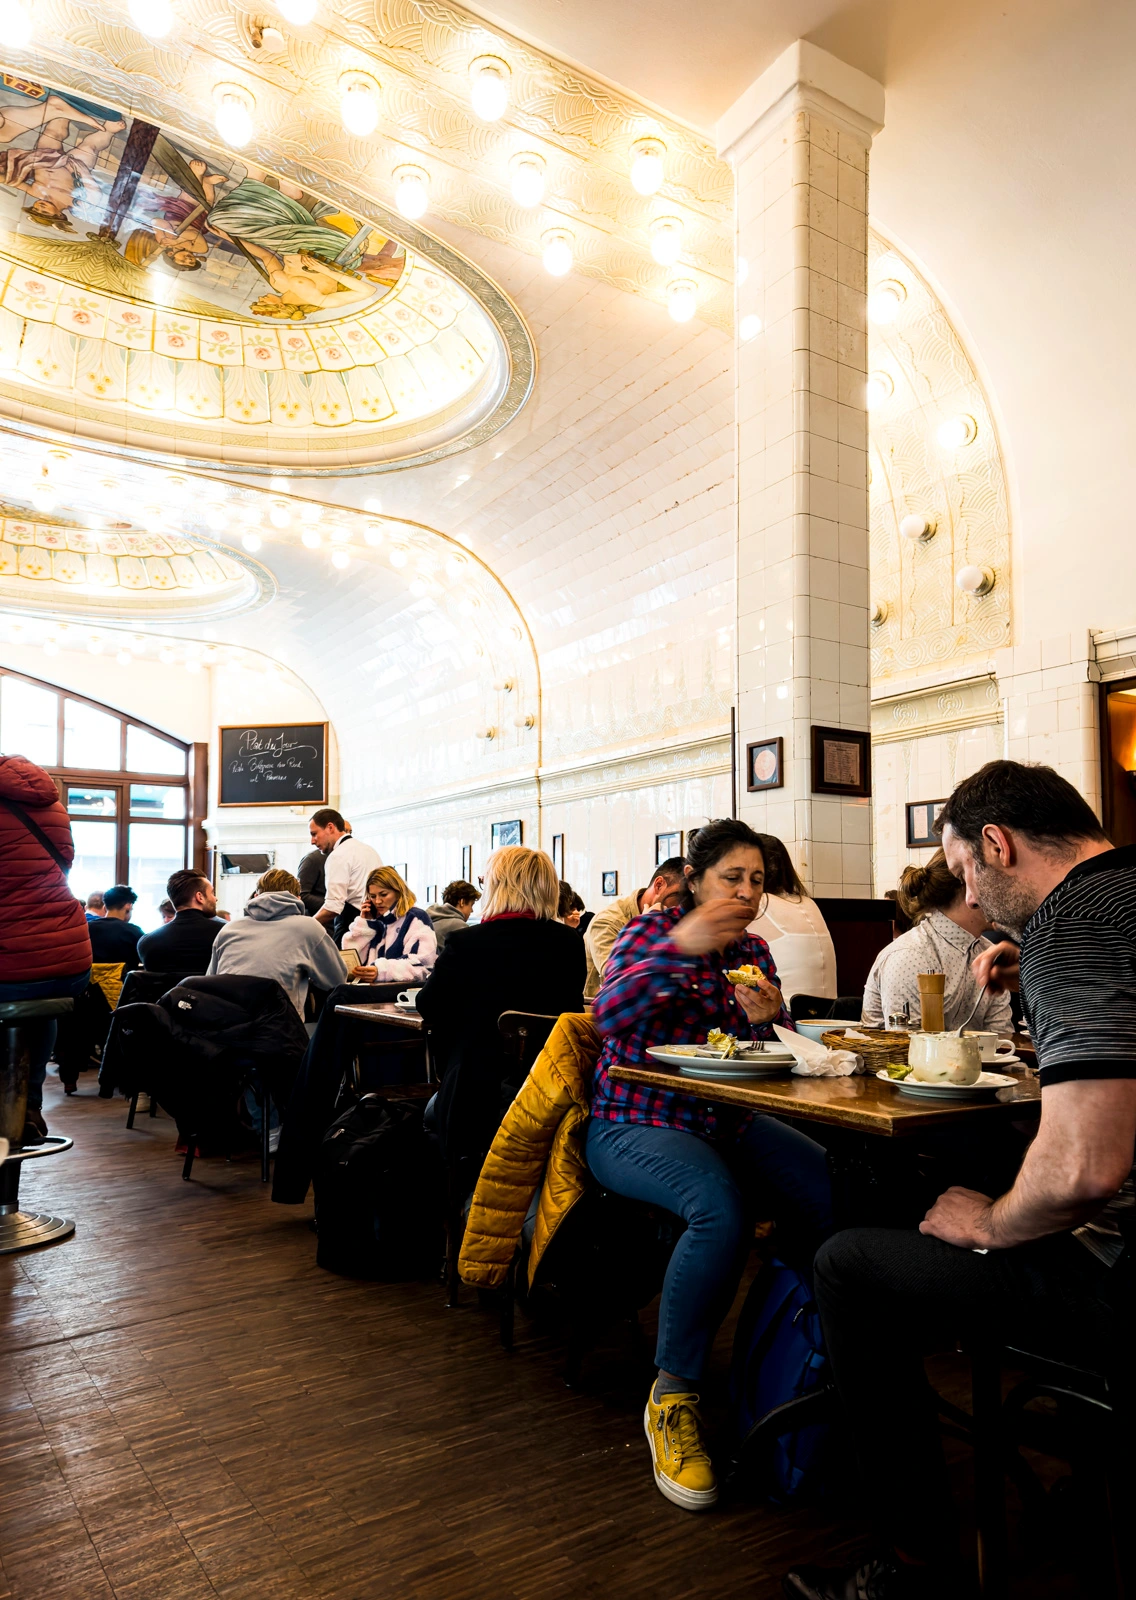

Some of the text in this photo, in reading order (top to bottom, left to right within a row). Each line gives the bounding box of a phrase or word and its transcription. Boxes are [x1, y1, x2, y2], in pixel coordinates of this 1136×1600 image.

[240, 730, 298, 757] Plat du Jour
